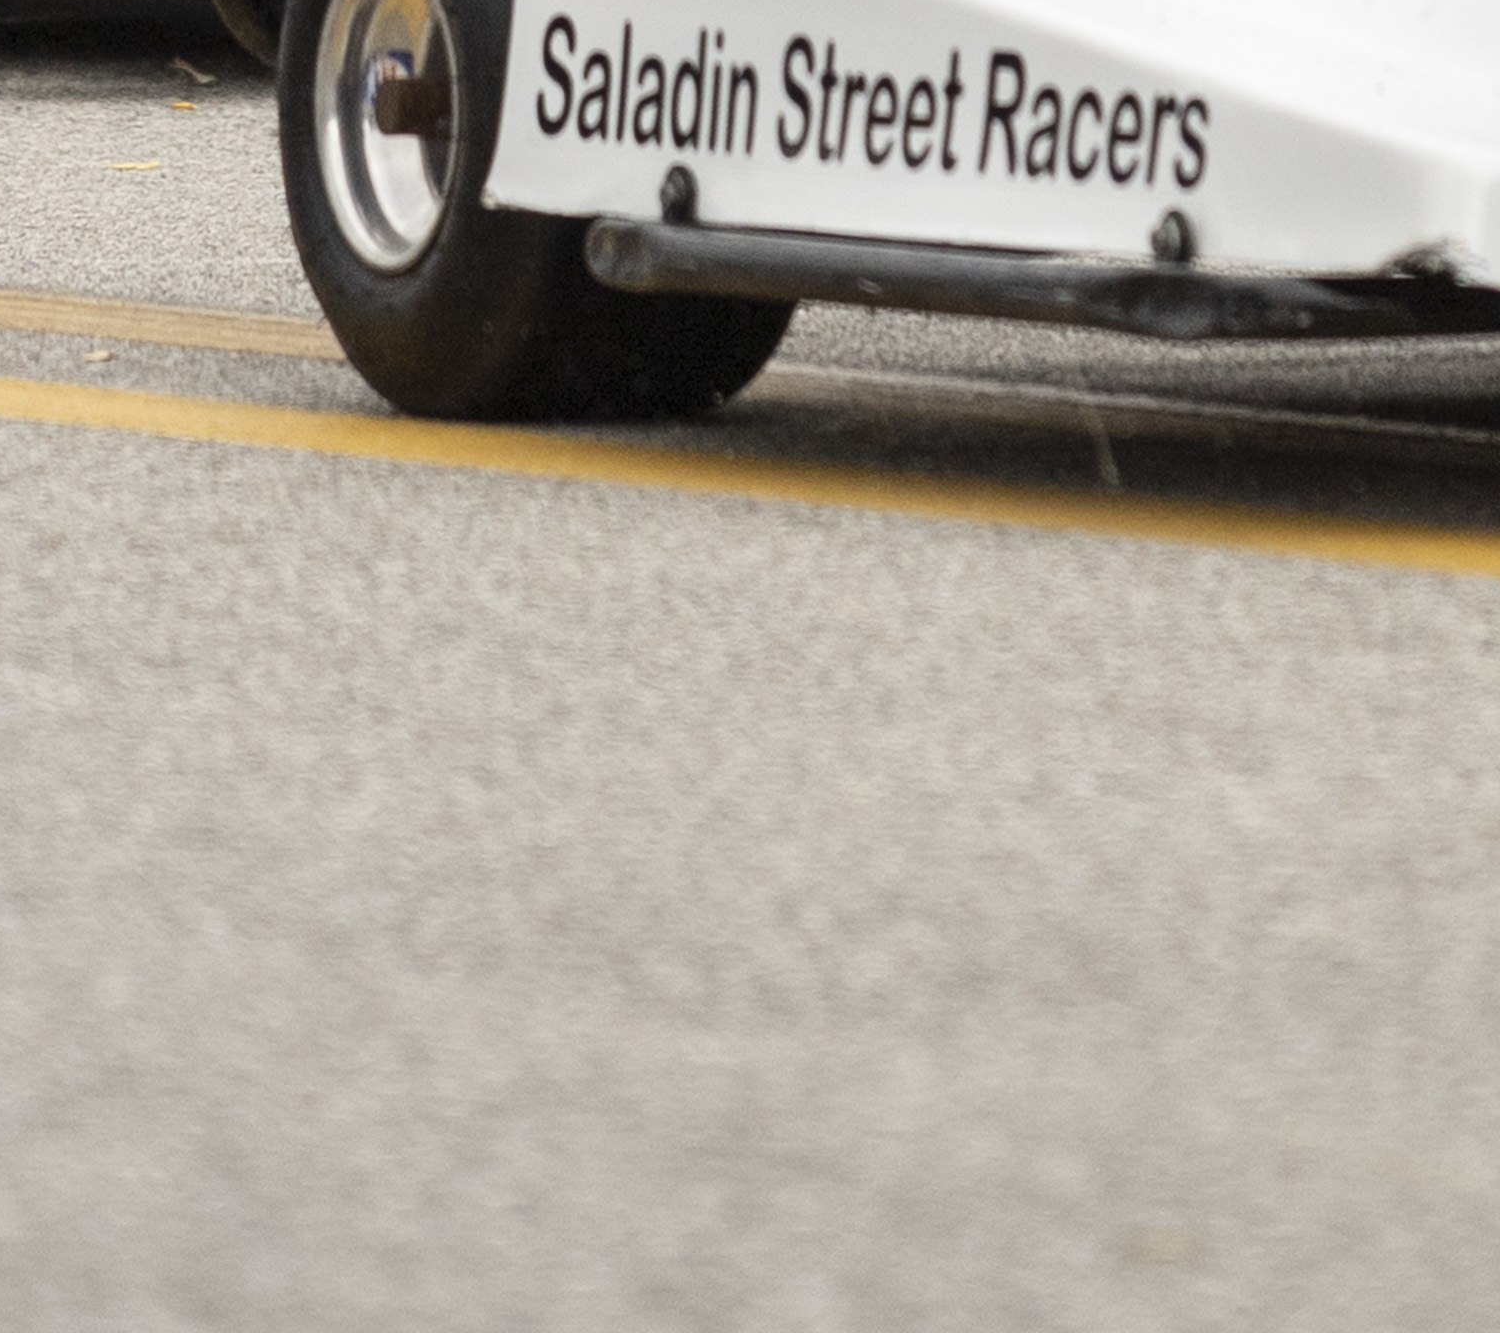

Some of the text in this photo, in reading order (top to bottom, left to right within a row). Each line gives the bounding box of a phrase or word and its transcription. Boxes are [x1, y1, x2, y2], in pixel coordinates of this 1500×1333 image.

[535, 13, 1211, 190] Saladin Street Racers
